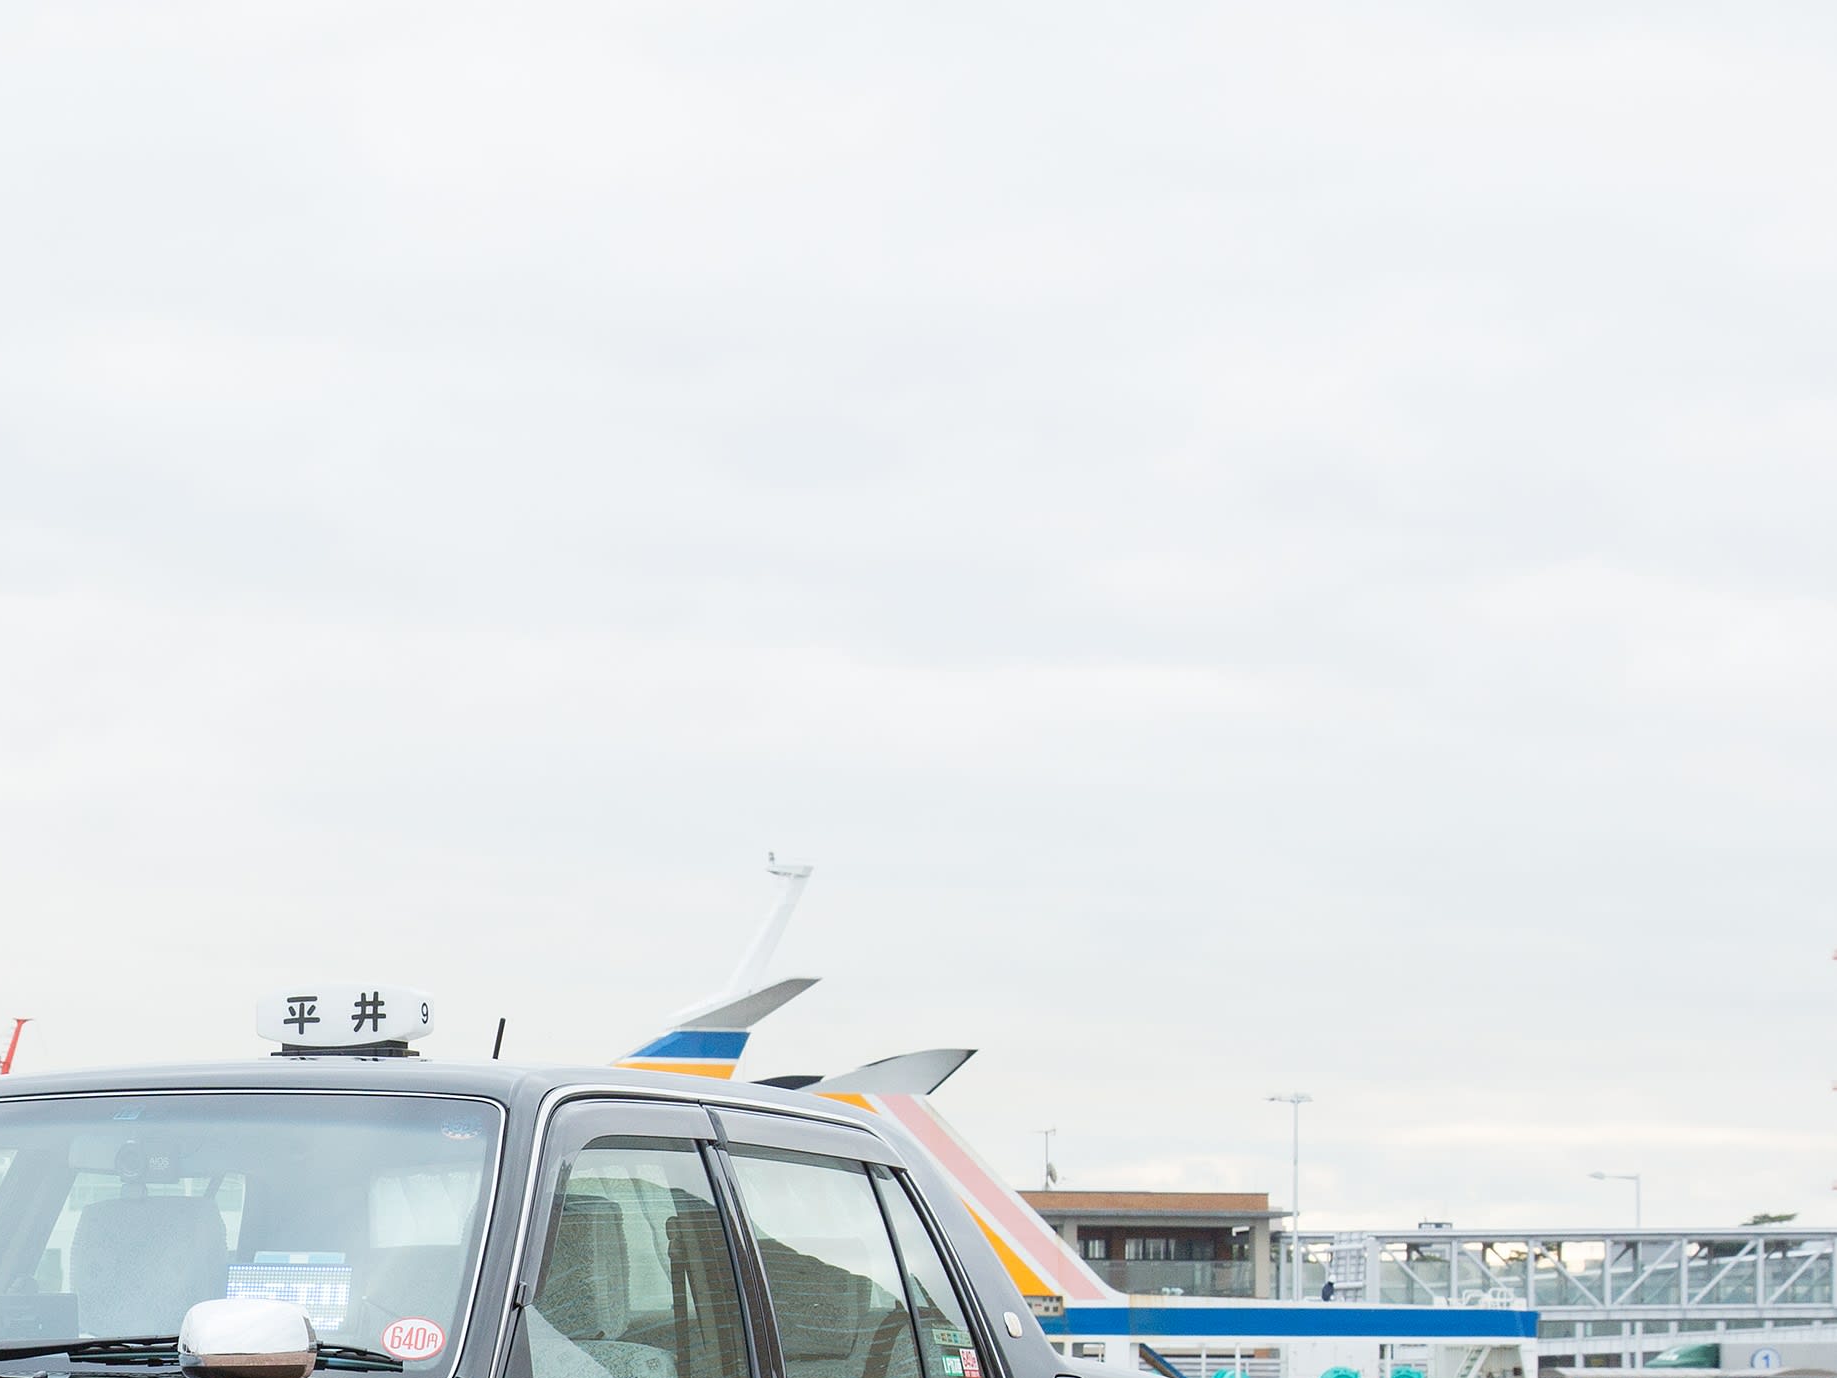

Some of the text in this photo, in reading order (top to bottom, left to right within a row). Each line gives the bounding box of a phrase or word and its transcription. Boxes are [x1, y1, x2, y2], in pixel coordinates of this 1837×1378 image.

[283, 991, 387, 1035] 平井
[420, 1002, 429, 1025] 9
[389, 1326, 439, 1351] 640円
